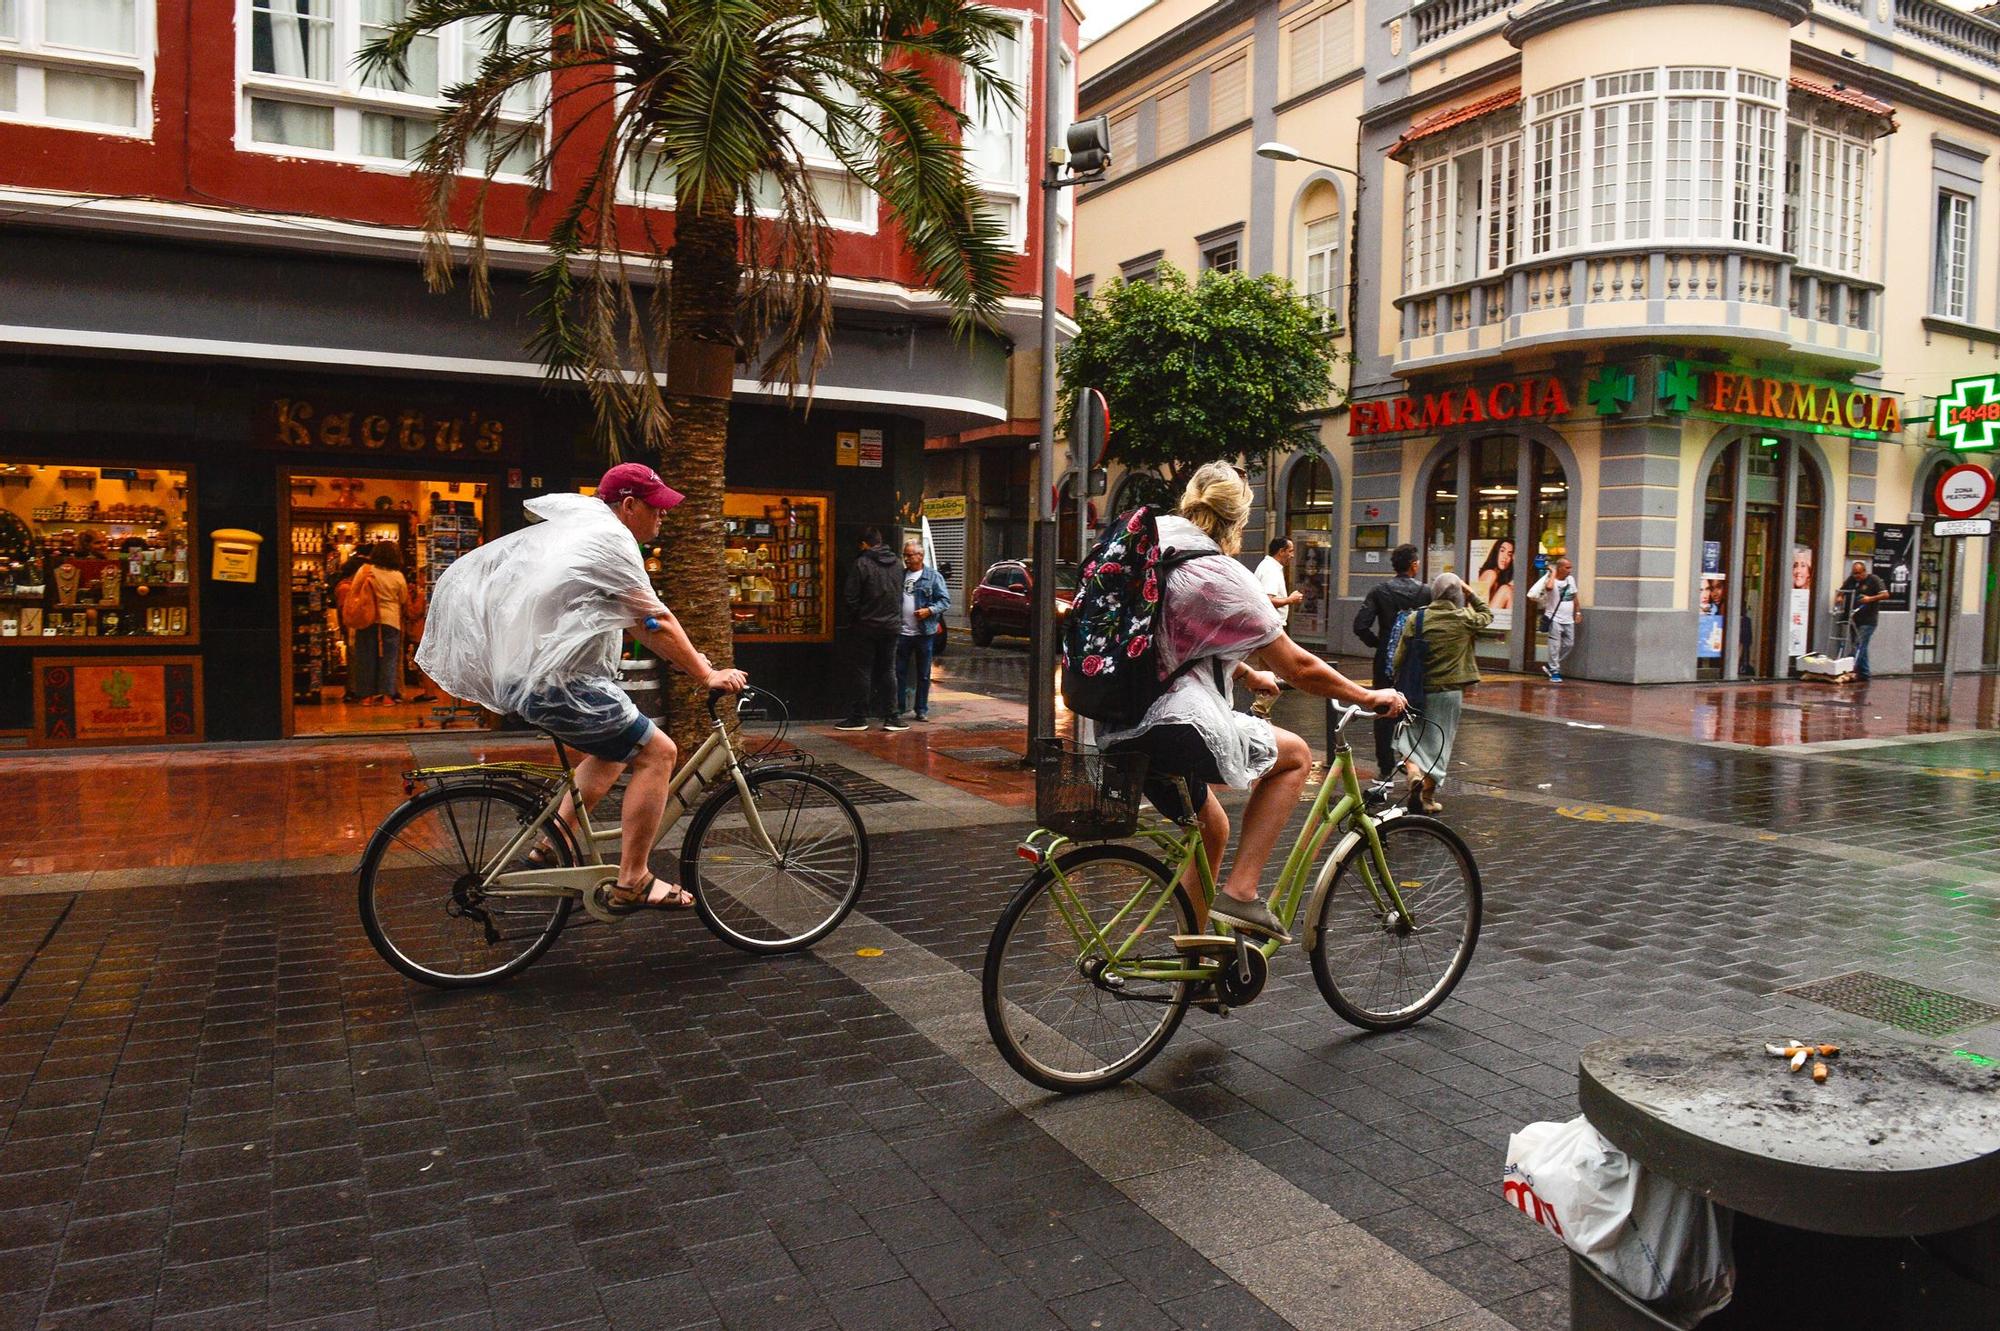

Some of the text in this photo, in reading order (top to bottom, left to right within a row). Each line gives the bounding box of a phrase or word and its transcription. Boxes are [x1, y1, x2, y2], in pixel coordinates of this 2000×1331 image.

[1347, 376, 1569, 436] FARMACIA
[1711, 371, 1901, 433] FARMACIA
[1949, 403, 2000, 424] 14:48
[1942, 527, 1982, 535] BICICLETAS
